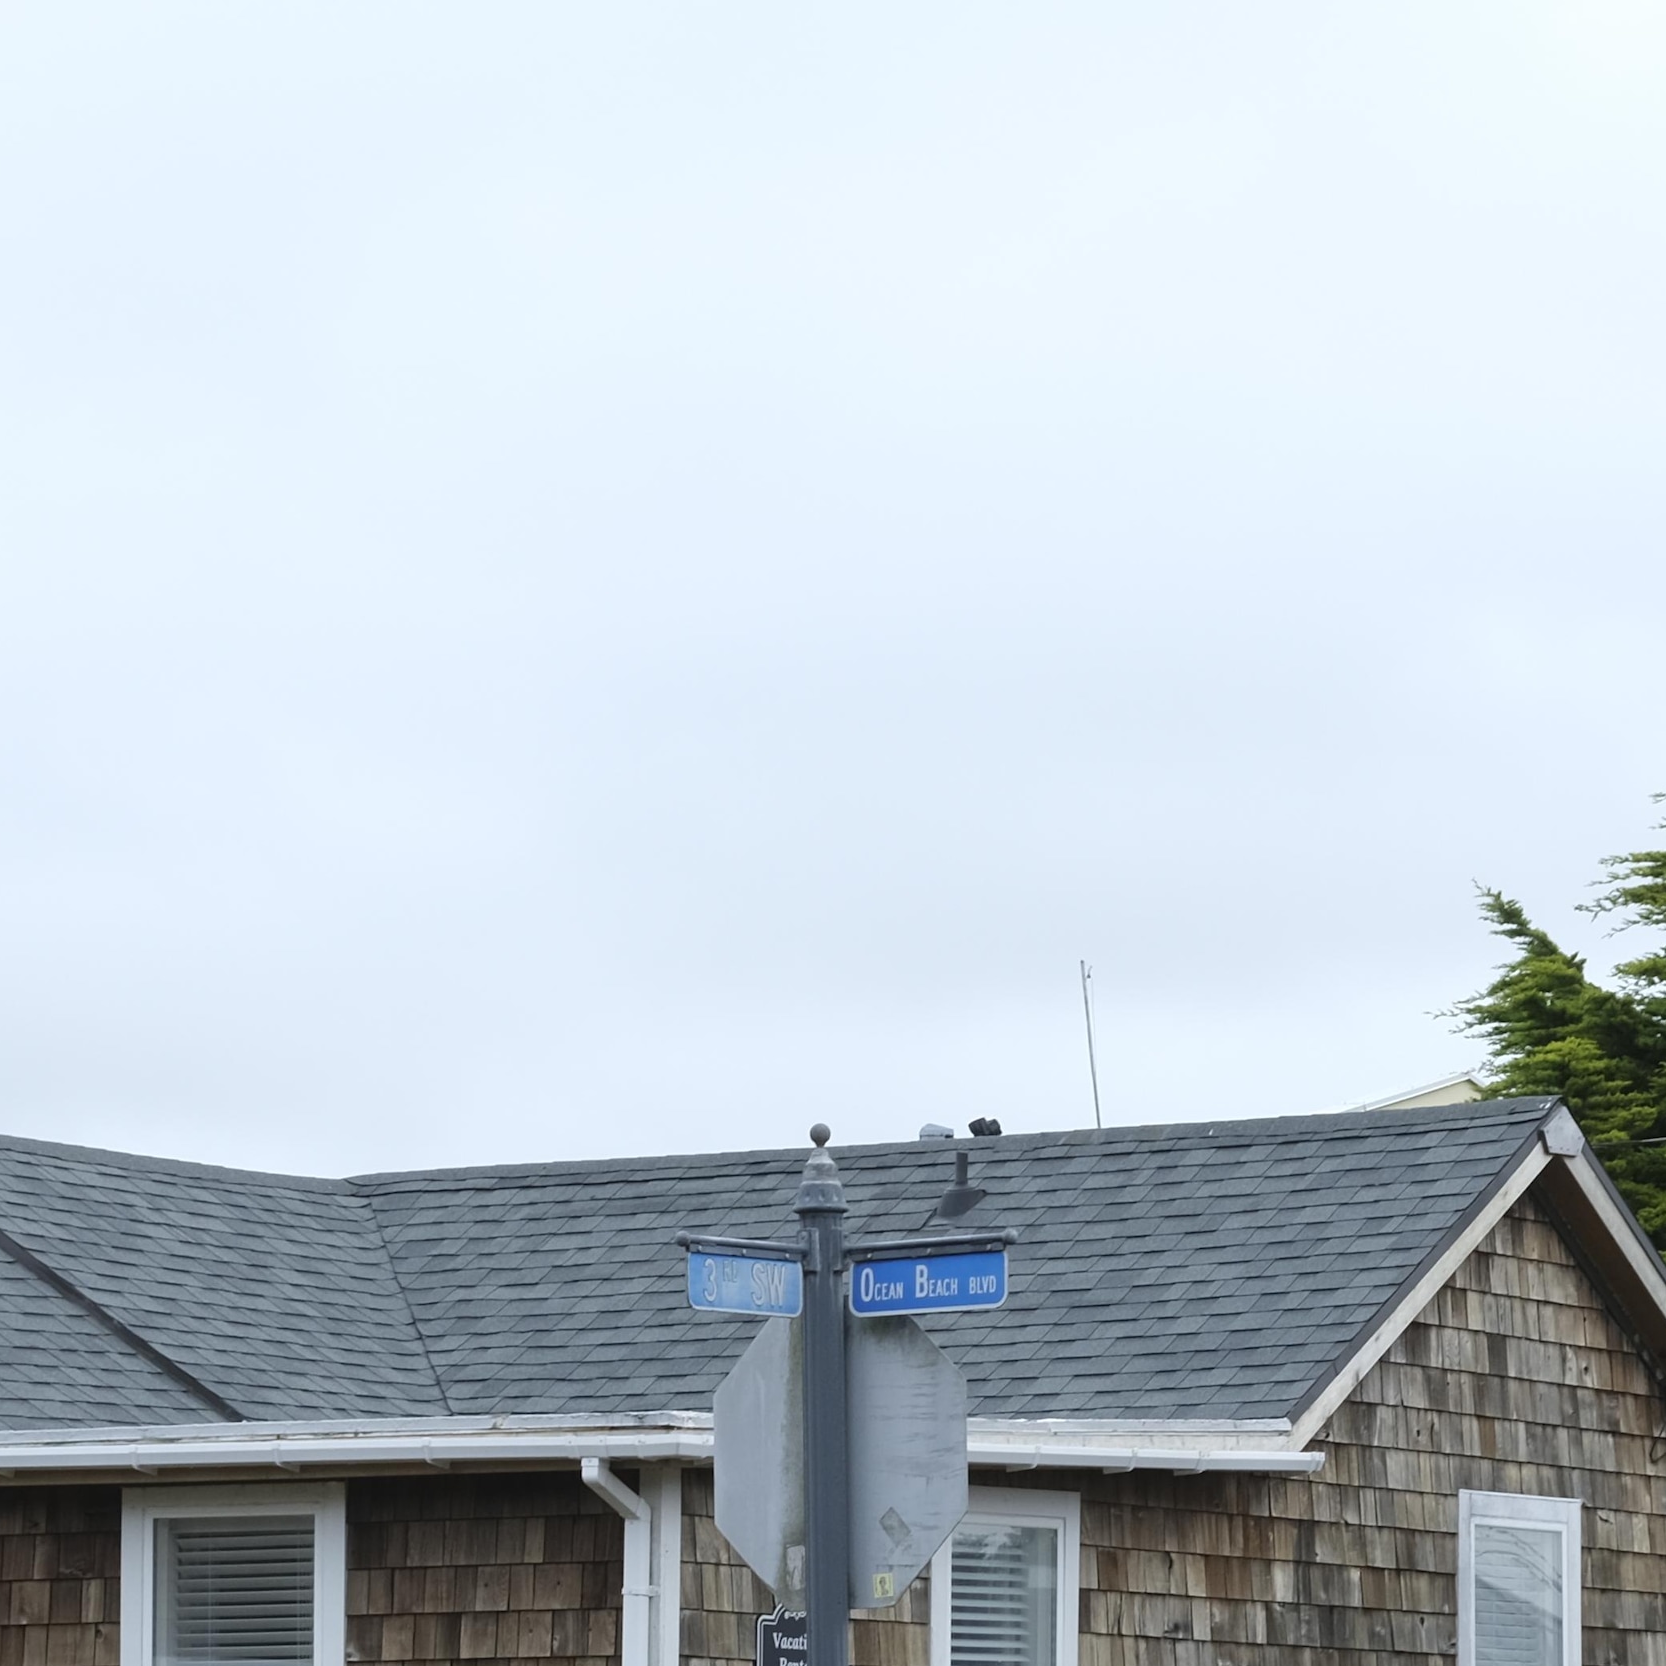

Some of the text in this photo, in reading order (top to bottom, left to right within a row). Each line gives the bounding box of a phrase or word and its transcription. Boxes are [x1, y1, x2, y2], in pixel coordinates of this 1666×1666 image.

[750, 1262, 787, 1307] SW
[969, 1275, 996, 1295] BLVD
[773, 1632, 808, 1650] Vacati
